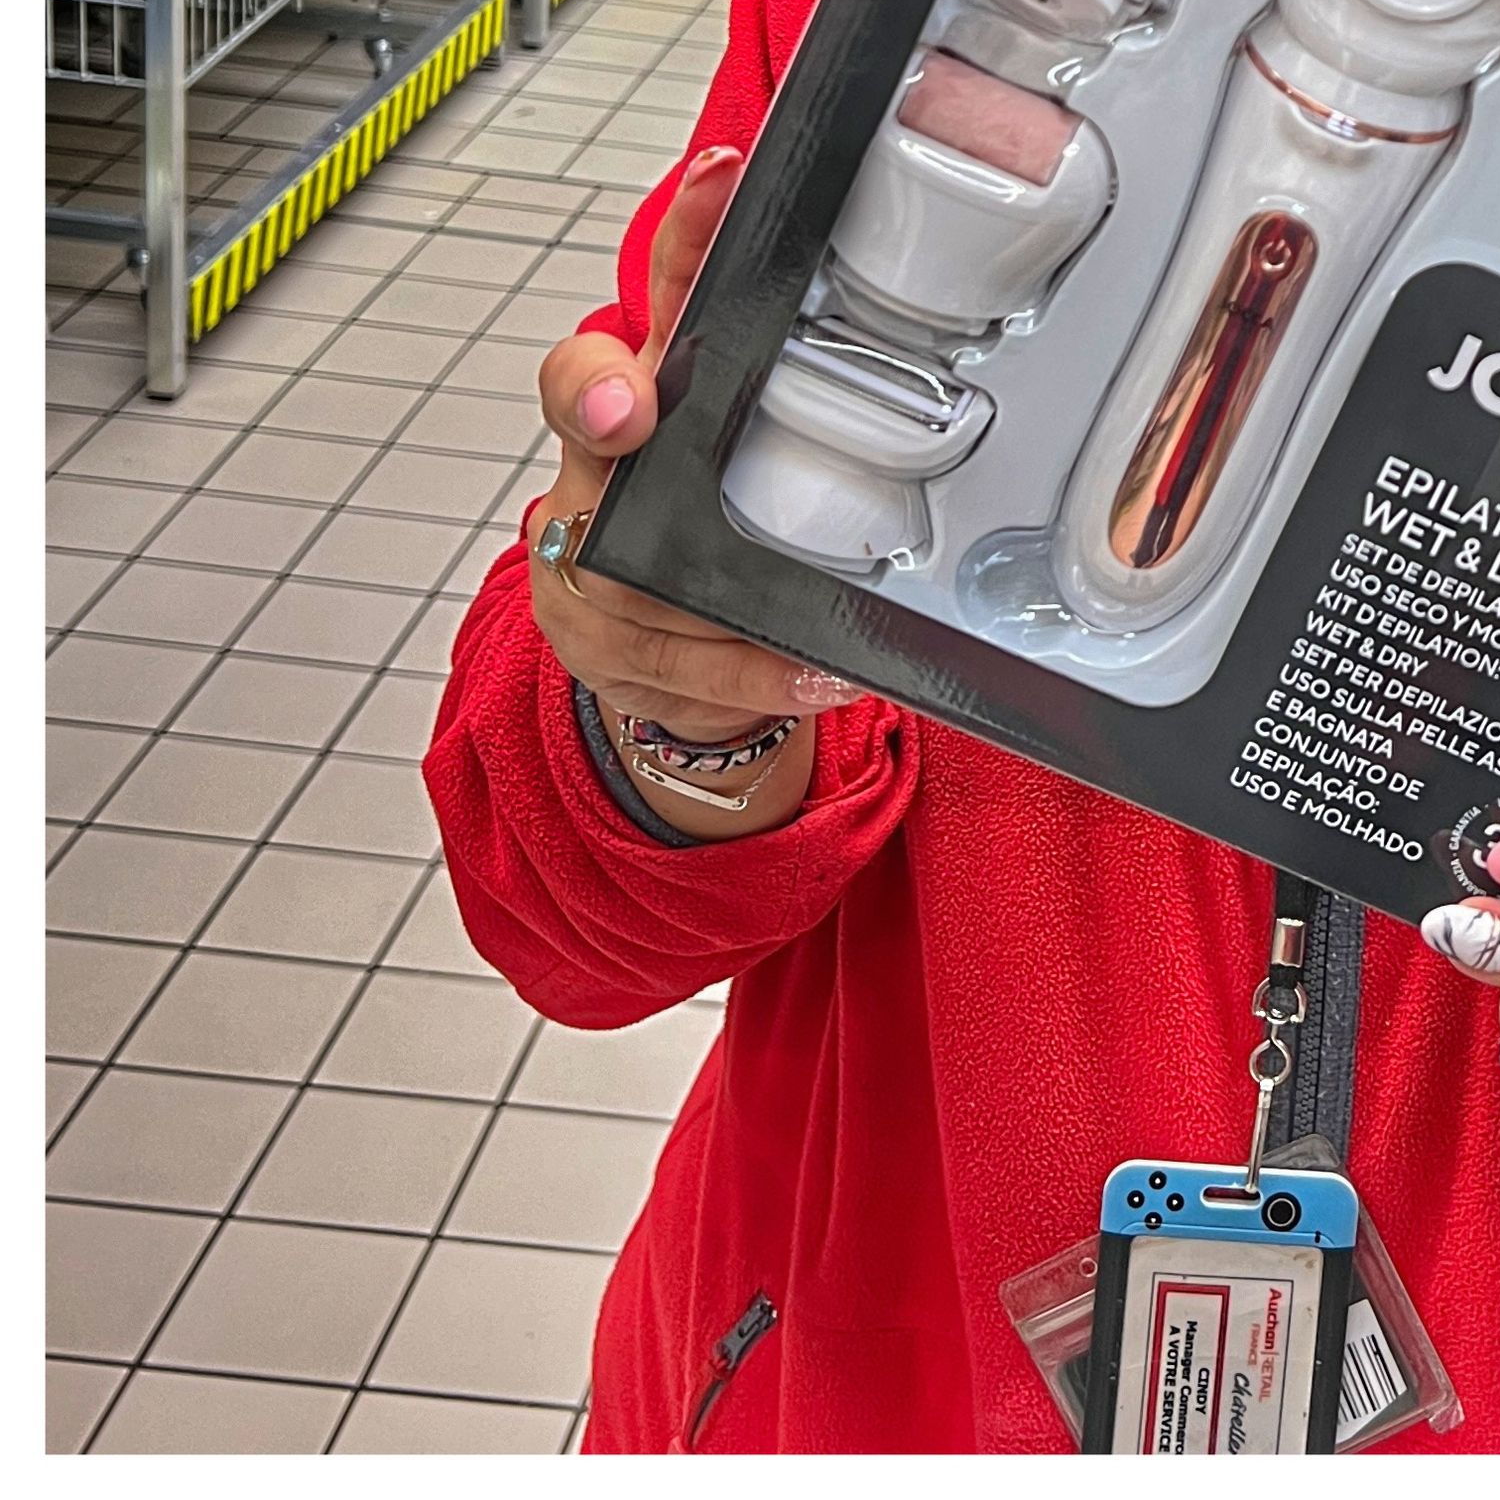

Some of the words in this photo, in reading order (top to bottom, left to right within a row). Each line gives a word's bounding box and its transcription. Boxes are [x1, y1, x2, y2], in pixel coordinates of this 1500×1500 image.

[1341, 533, 1389, 566] SET
[1385, 553, 1423, 584] DE
[1363, 491, 1457, 557] WET
[1454, 537, 1481, 573] &
[1316, 584, 1358, 616] KIT
[1330, 558, 1382, 596] USO
[1381, 584, 1449, 625] SECO
[1452, 610, 1470, 632] Y
[1290, 637, 1338, 670] SET
[1334, 657, 1384, 693] PER
[1306, 610, 1361, 649] WET
[1358, 636, 1375, 659] &
[1376, 644, 1429, 677] DRY
[1266, 689, 1287, 712] E
[1284, 697, 1393, 759] BAGNATA
[1279, 663, 1331, 699] USO
[1330, 687, 1403, 733] SULLA
[1405, 717, 1480, 763] PELLE
[1241, 741, 1380, 814] DEPILAÇÃO:
[1254, 717, 1387, 785] CONJUNTO
[1387, 772, 1425, 801] DE
[1230, 766, 1281, 801] USO
[1281, 789, 1302, 811] E
[1300, 798, 1423, 861] MOLHADO
[1448, 805, 1482, 851] GARANTIA
[1169, 1325, 1181, 1336] A
[1248, 1322, 1261, 1366] FRANCE
[1263, 1287, 1282, 1350] Auchan
[1165, 1339, 1180, 1387] VOTRE
[1181, 1320, 1198, 1382] Manager
[1158, 1390, 1175, 1453] SERVICE
[1175, 1385, 1192, 1455] Commerc
[1195, 1367, 1210, 1415] CINDY
